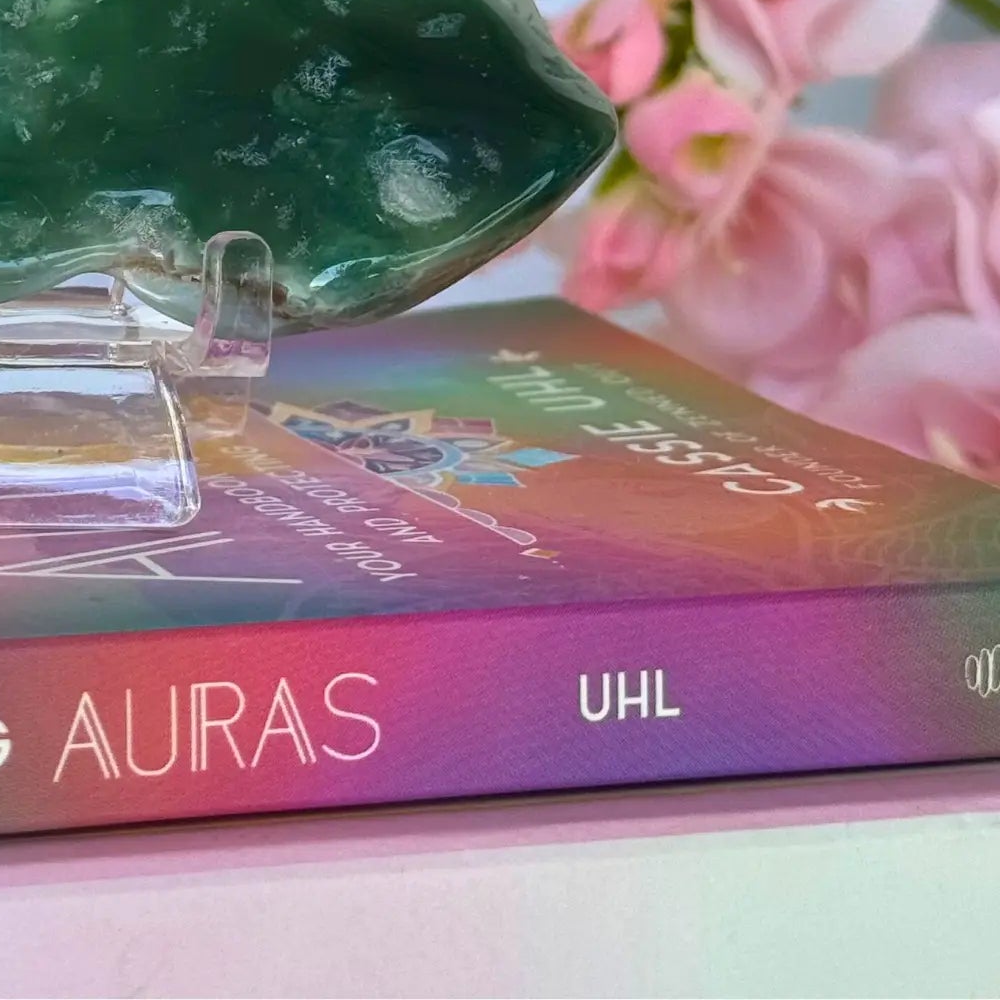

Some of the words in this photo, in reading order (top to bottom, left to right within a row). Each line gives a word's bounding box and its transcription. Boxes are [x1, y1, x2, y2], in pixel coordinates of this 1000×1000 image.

[486, 364, 606, 412] UHL
[578, 419, 805, 496] CASSIE
[752, 443, 881, 489] FOUNDER
[363, 516, 444, 544] AND
[325, 541, 418, 582] YOUR
[578, 668, 682, 722] UHL
[52, 672, 381, 783] AURAS
